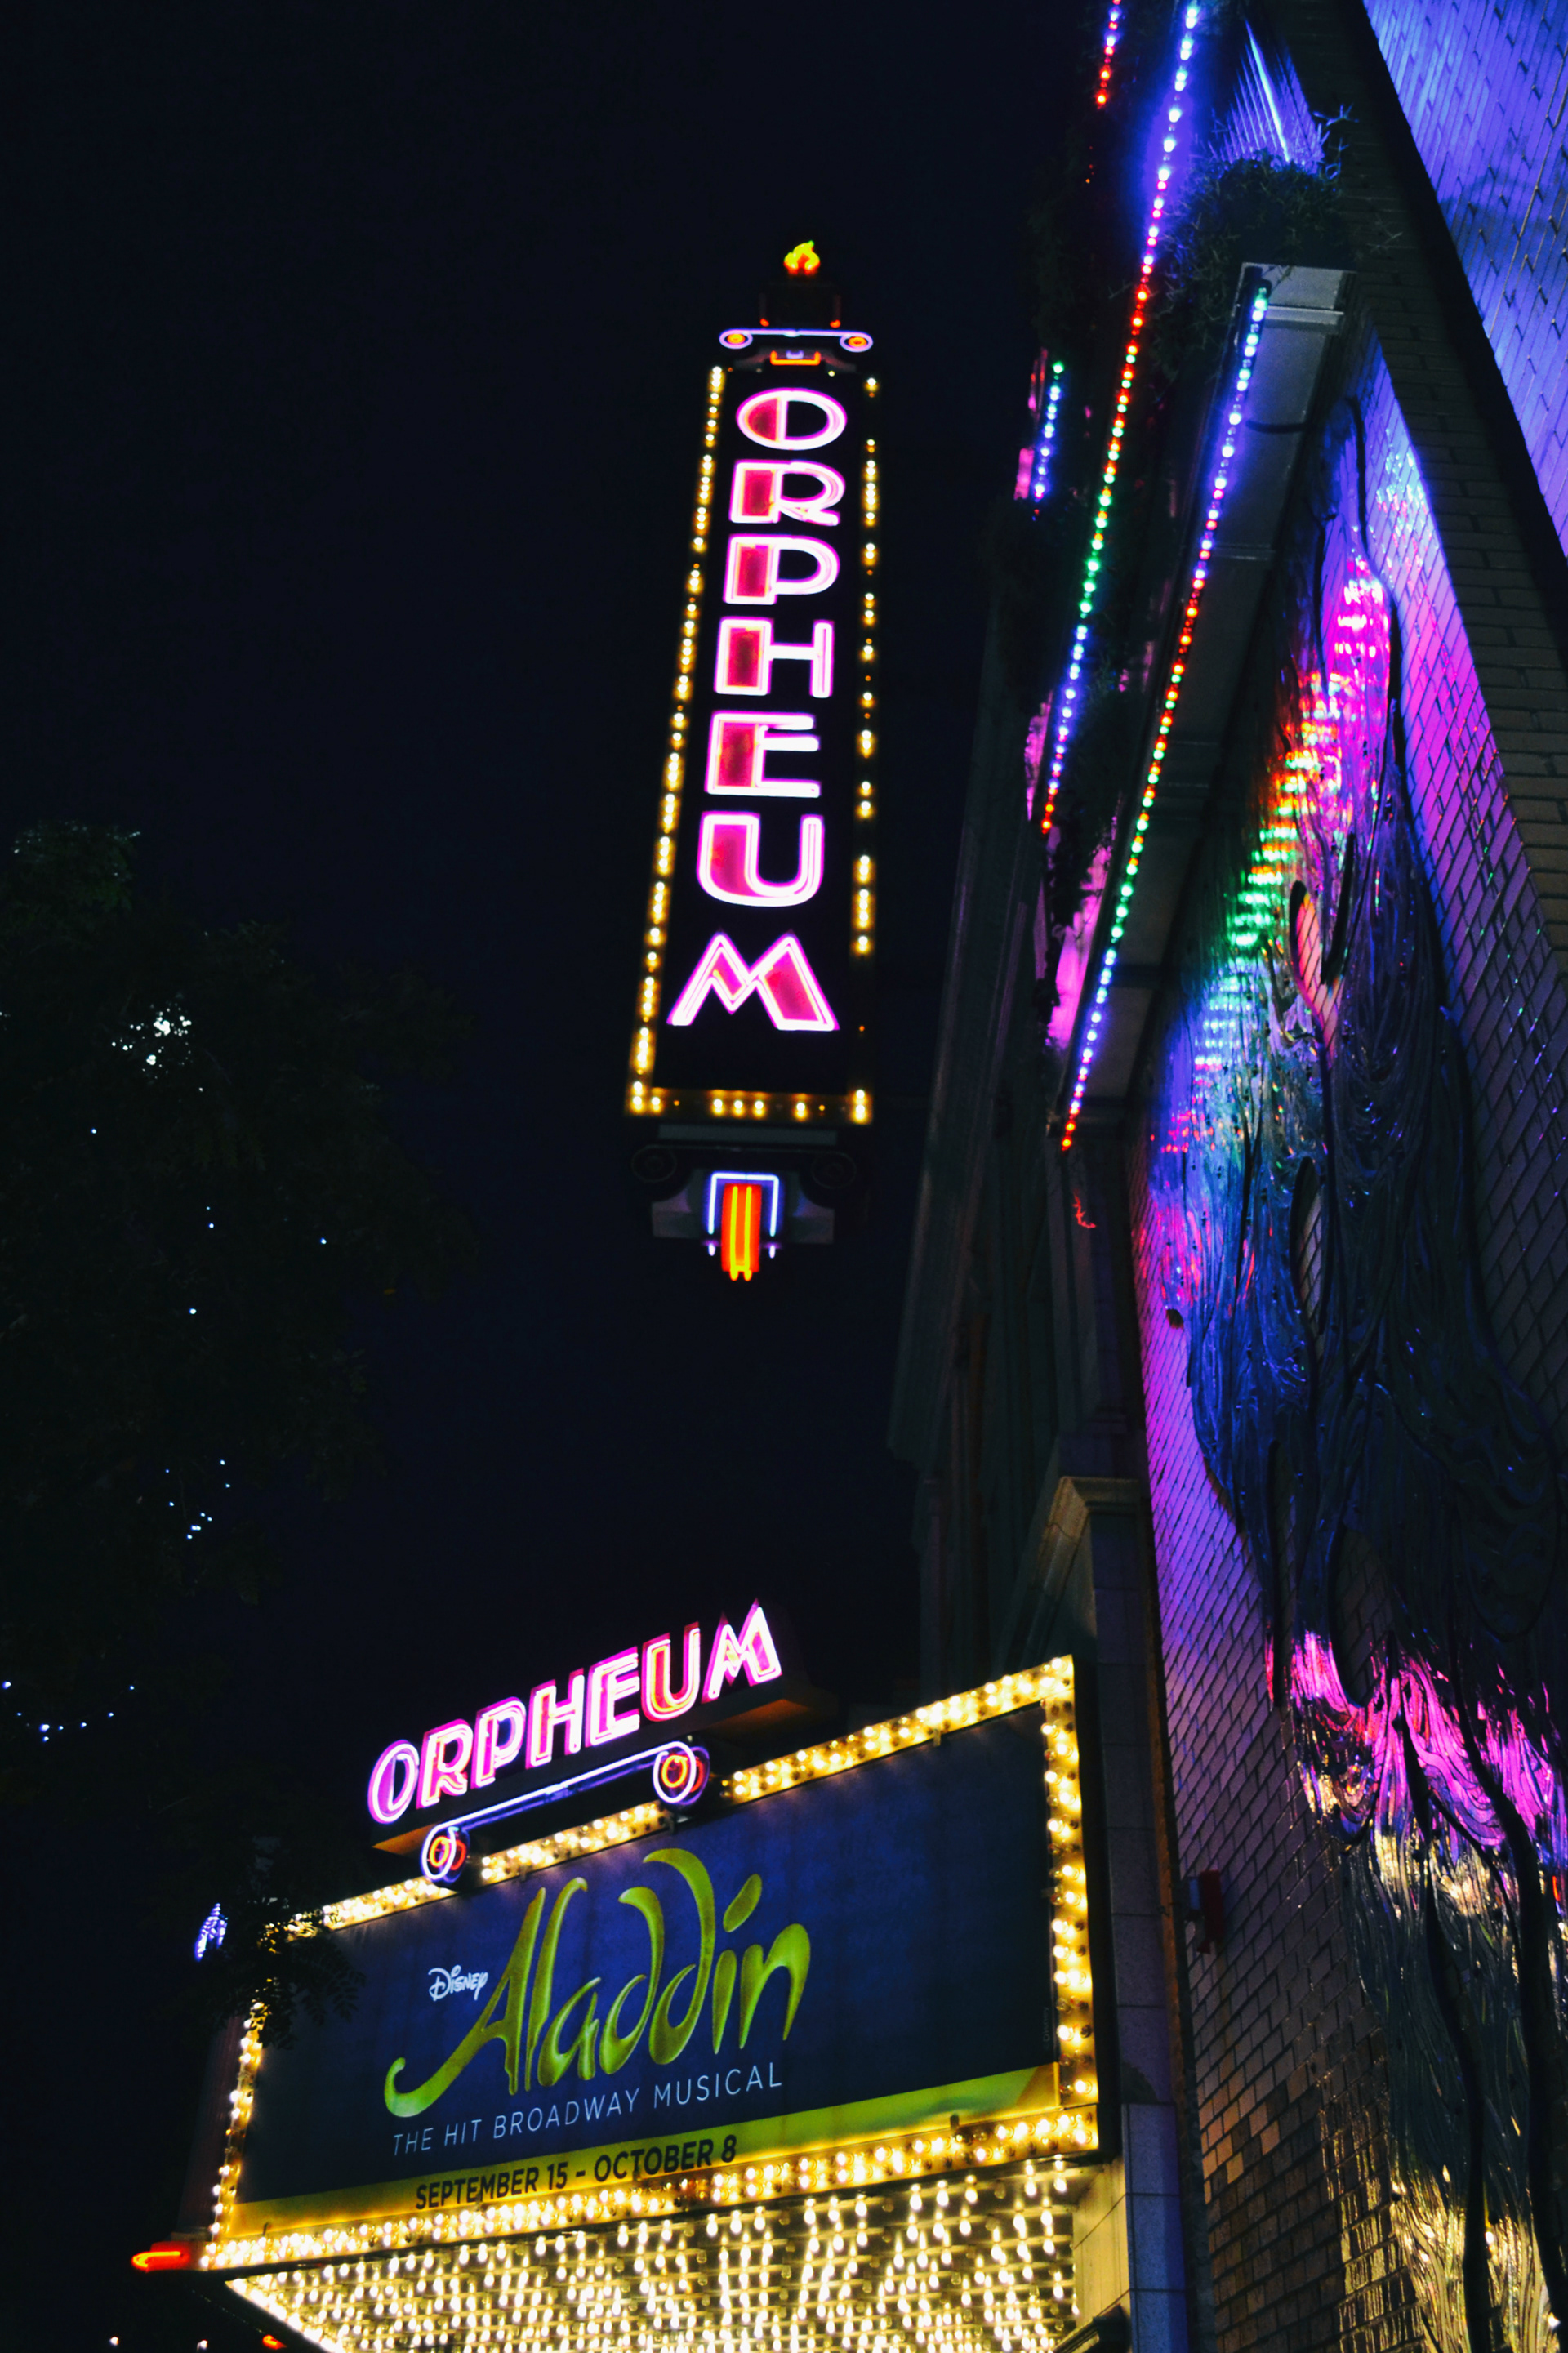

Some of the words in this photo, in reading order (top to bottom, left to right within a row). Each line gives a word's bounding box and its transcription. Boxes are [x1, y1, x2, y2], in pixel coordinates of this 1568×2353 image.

[666, 387, 847, 1032] ORPHEUM
[368, 1598, 783, 1825] ORPHEUM
[384, 1848, 811, 2117] Aladdin
[394, 2127, 434, 2155] THE
[444, 2119, 483, 2146] HIT
[493, 2088, 639, 2139] BROADWAY
[654, 2062, 782, 2109] MUSICAL
[416, 2166, 539, 2210] SEPTEMBER
[546, 2162, 568, 2190] 15
[594, 2138, 714, 2182] OCTOBER
[720, 2134, 737, 2163] 8
